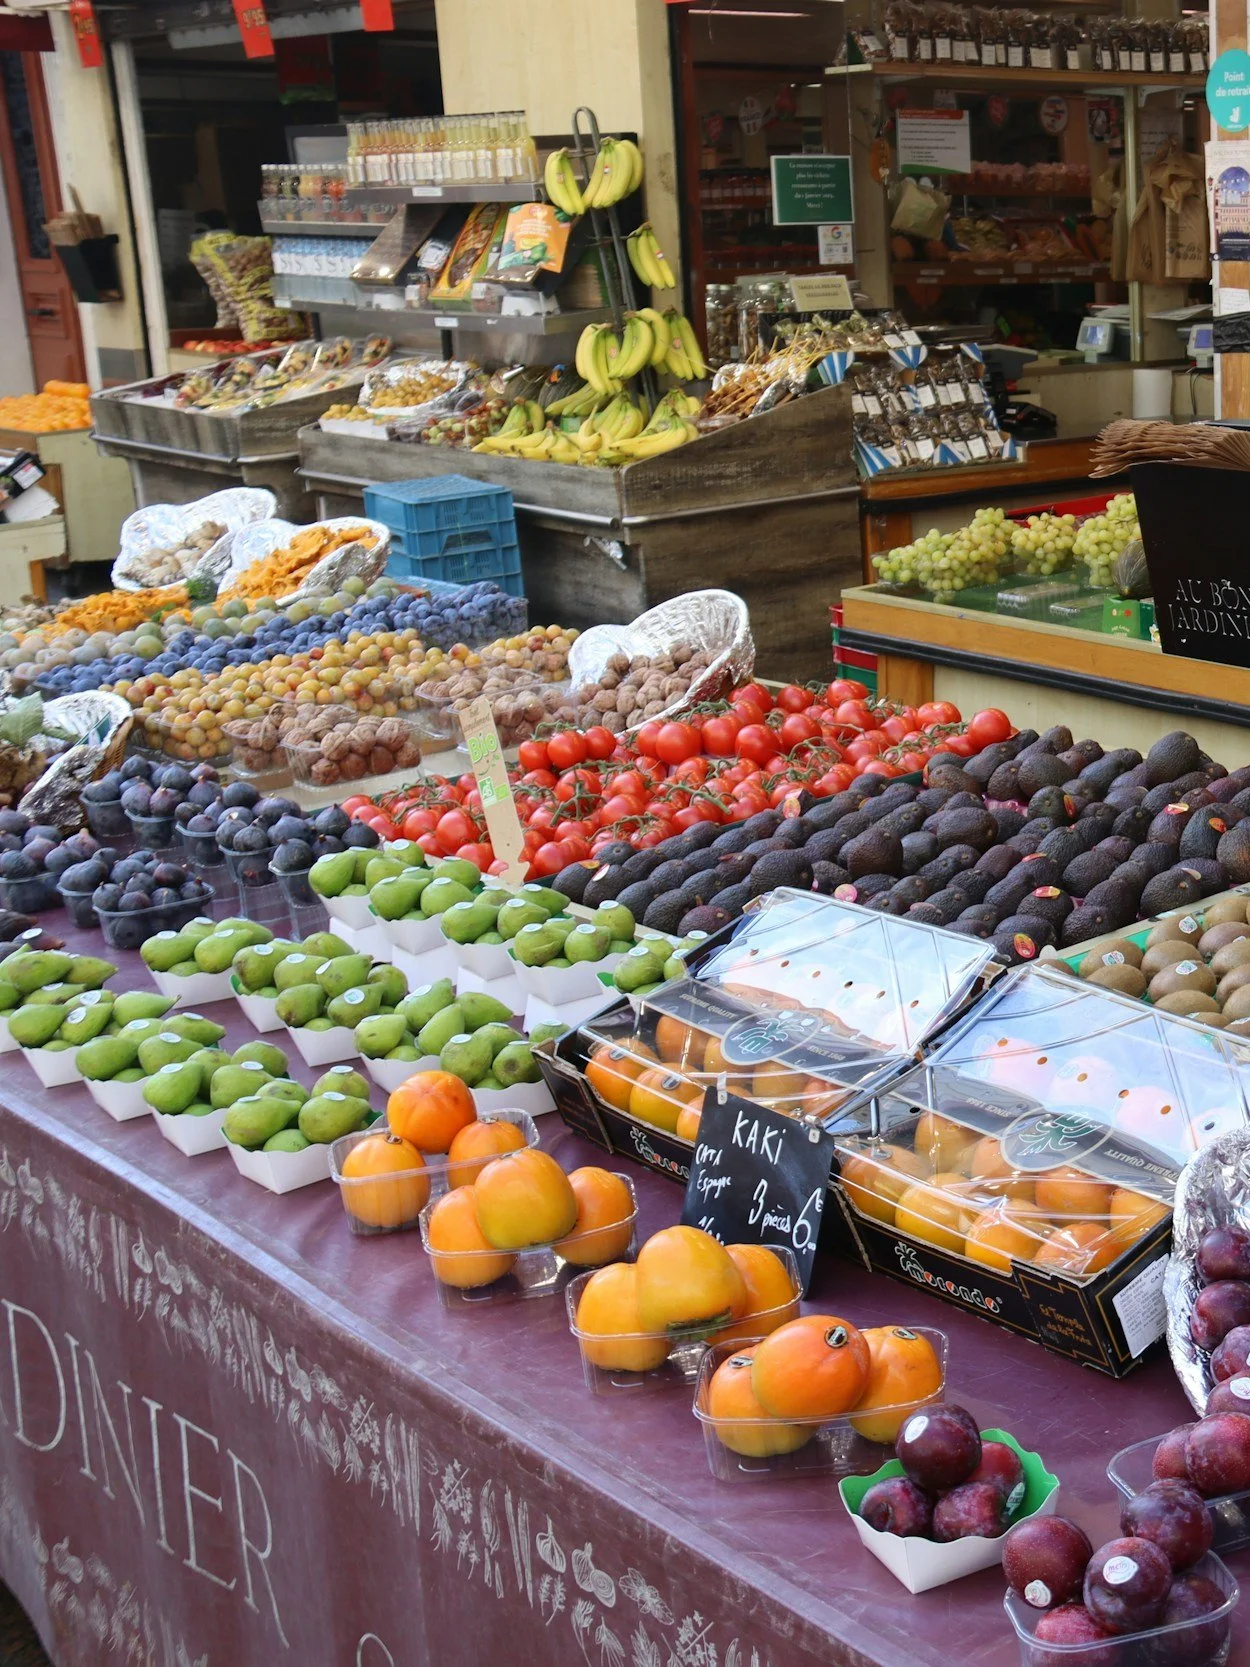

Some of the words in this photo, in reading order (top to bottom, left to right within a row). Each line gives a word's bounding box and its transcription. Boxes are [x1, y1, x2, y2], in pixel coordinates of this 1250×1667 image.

[1224, 71, 1245, 82] Point
[1216, 85, 1226, 97] de
[1176, 579, 1202, 604] AU
[707, 1005, 740, 1020] QUALITY
[1103, 1149, 1145, 1169] QUALITY
[1145, 1163, 1180, 1184] PREME
[1120, 1278, 1143, 1298] SUPREME
[1143, 1260, 1164, 1279] QUALITY
[0, 1299, 289, 1650] DINIER
